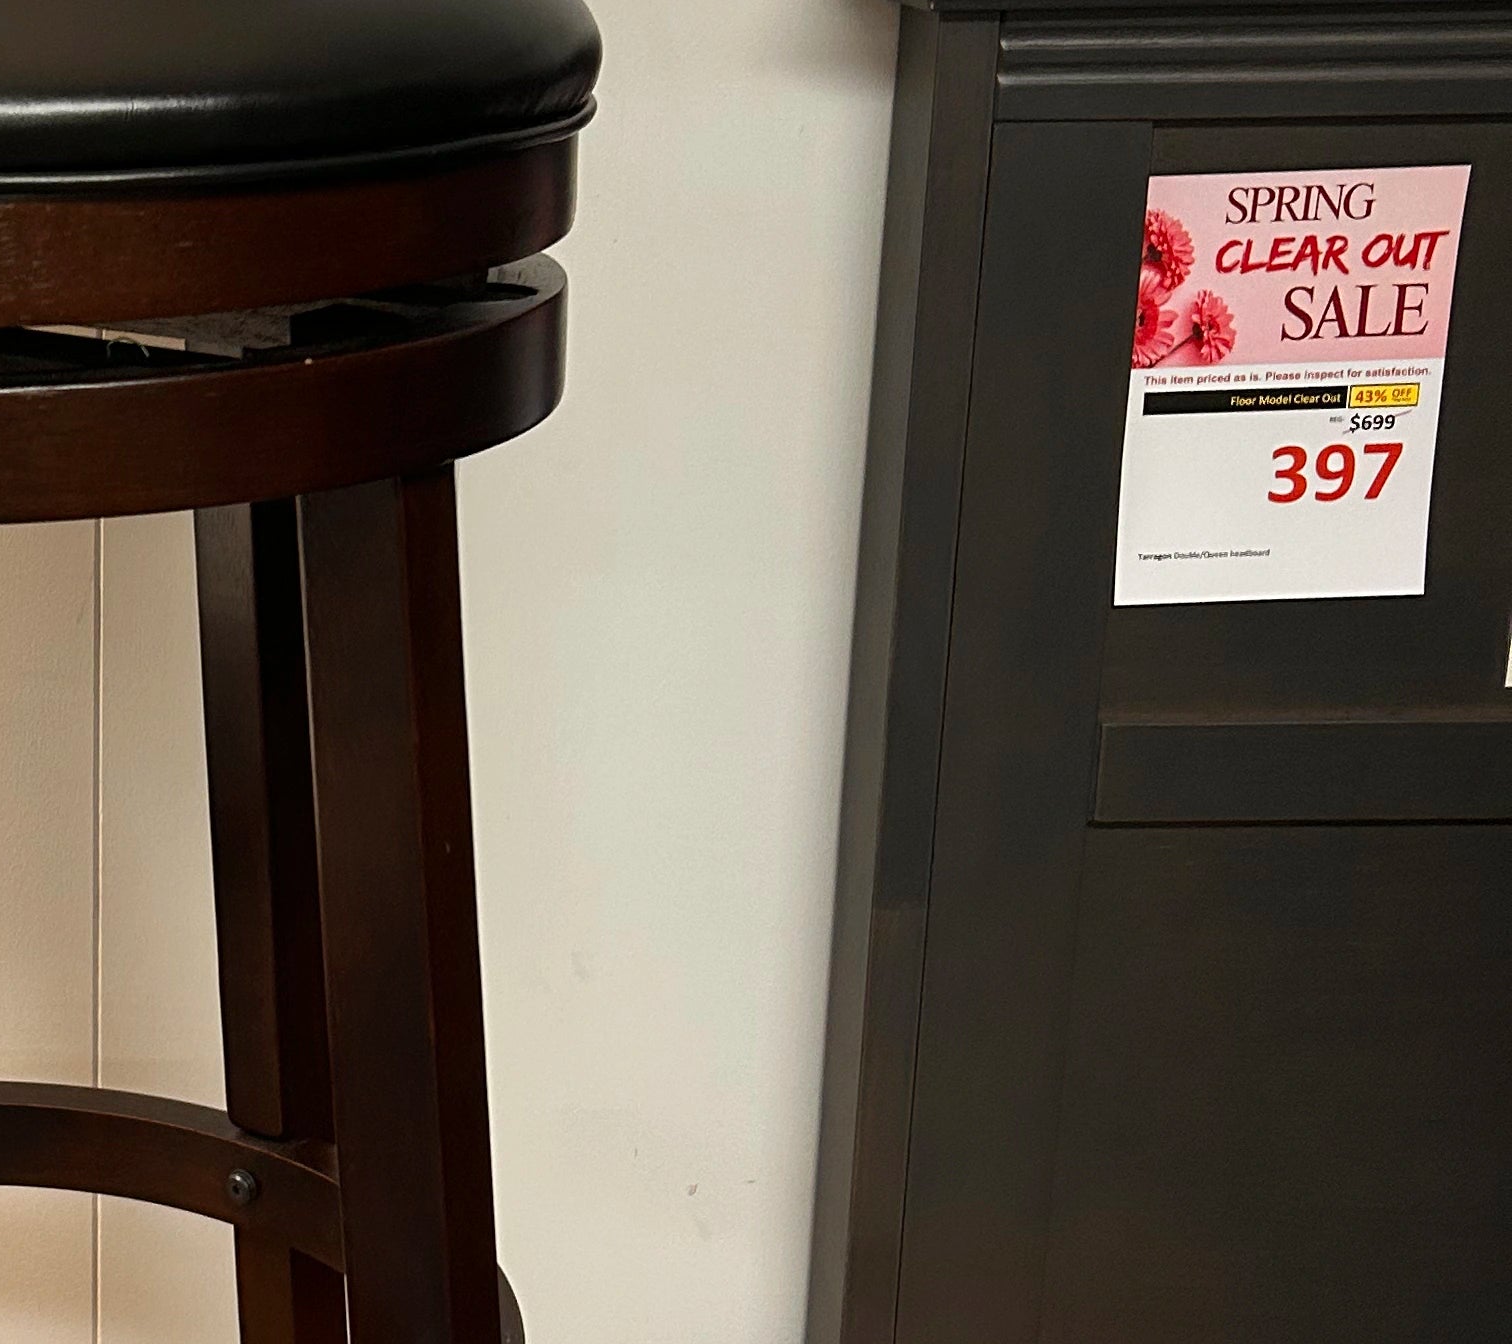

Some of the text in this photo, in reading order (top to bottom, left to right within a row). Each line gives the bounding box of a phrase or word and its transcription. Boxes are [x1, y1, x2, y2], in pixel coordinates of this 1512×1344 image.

[1226, 182, 1376, 225] SPRING
[1215, 230, 1450, 276] CLEAR OUT
[1281, 282, 1429, 342] SALE
[1144, 375, 1167, 386] This
[1169, 374, 1194, 385] item
[1196, 373, 1231, 385] priced
[1234, 374, 1246, 383] as
[1265, 371, 1301, 382] Please
[1304, 369, 1344, 381] inspect
[1347, 368, 1362, 378] for
[1365, 366, 1432, 377] satisfaction.
[1231, 392, 1341, 407] Floor Model Clear Out
[1355, 389, 1387, 403] 43%
[1391, 387, 1413, 398] OFF
[1349, 412, 1396, 434] $699
[1267, 442, 1404, 504] 397
